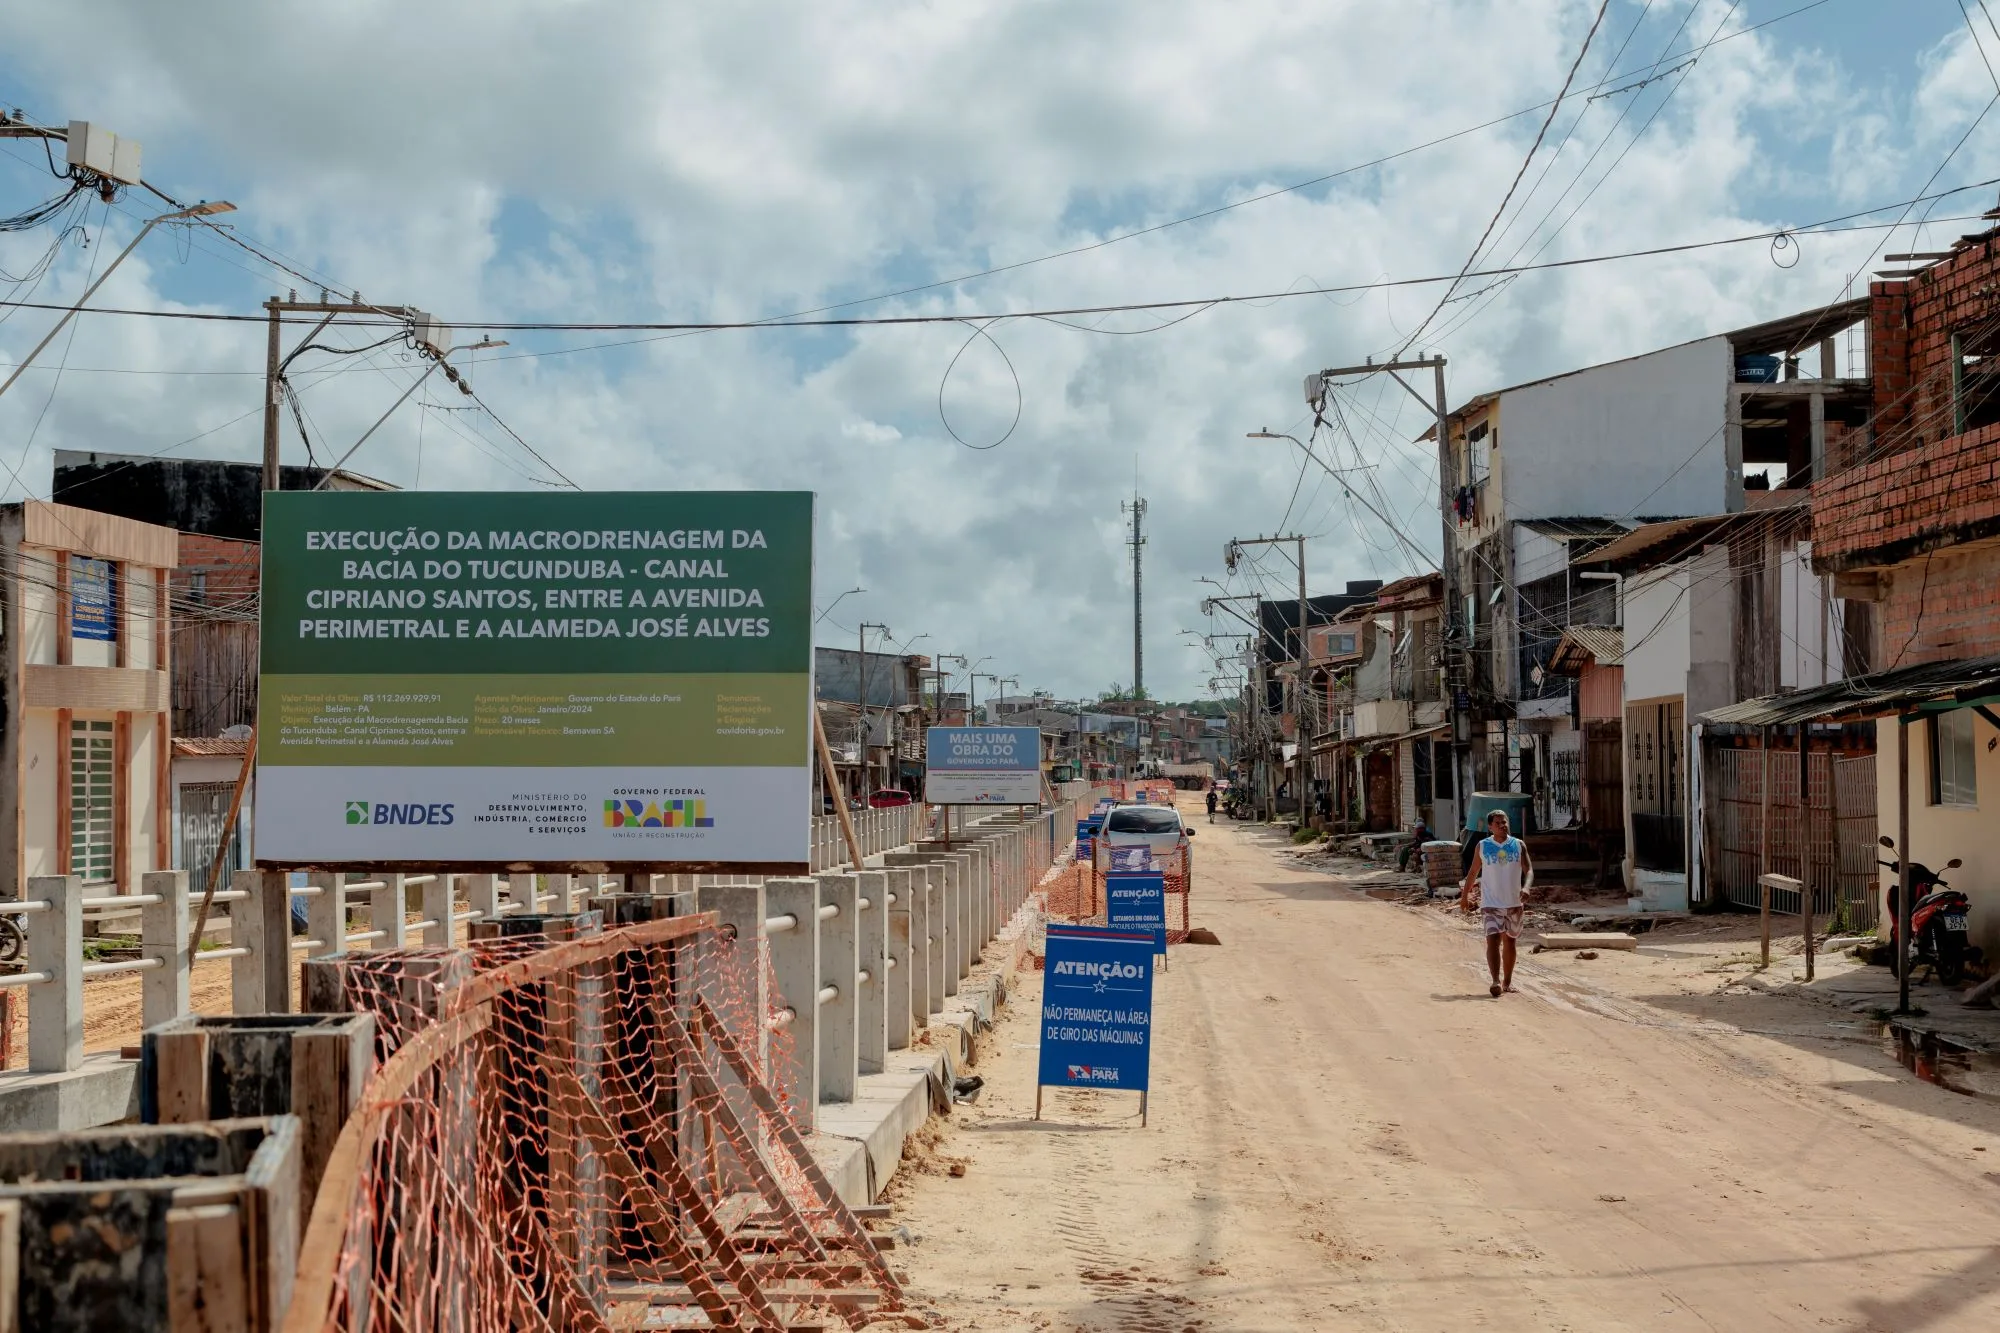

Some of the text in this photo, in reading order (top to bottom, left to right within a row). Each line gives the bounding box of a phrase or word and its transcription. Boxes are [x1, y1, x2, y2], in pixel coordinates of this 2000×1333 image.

[306, 527, 768, 555] EXECUÇÃO DA MACRODRENAGEM DA
[343, 560, 417, 580] BACIA
[424, 560, 462, 580] DO
[468, 560, 624, 579] TUCUNDUBA
[644, 559, 728, 578] CANAL
[306, 588, 764, 612] CIPRIANO SANTOS, ENTRE A AVENIDA
[300, 614, 770, 638] PERIMETRAL E A ALAMEDA JOSÉ ALVES
[281, 694, 302, 702] Valor
[364, 694, 374, 702] R$
[376, 694, 441, 703] 112.269.929,91
[568, 694, 604, 702] Governo
[606, 694, 617, 702] do
[620, 694, 647, 702] Estado
[650, 694, 661, 702] do
[663, 694, 681, 702] Pará
[326, 705, 351, 713] Belém
[537, 705, 592, 713] Janeiro/2024
[313, 716, 352, 725] Execução
[354, 716, 365, 724] da
[446, 716, 468, 724] Bacia
[502, 716, 512, 724] 20
[370, 727, 405, 736] Cipriano
[406, 727, 436, 735] Santos,
[603, 727, 615, 735] SA
[717, 726, 784, 736] ouvidoria.gov.br
[280, 737, 313, 745] Avenida
[315, 737, 356, 745] Perimetral
[372, 737, 408, 745] Alameda
[411, 737, 429, 745] José
[432, 737, 454, 745] Alves
[950, 734, 1017, 744] MAIS UMA
[952, 745, 1013, 756] OBRA DO
[374, 804, 454, 825] BNDES
[474, 814, 587, 823] INDÚSTRIA, COMÉRCIO
[604, 800, 714, 827] BRASIL
[538, 826, 586, 834] SERVIÇOS
[646, 832, 705, 840] RECONSTRUÇÃO
[1112, 888, 1159, 899] ATENÇÃO!
[1054, 960, 1144, 980] ATENÇÃO!
[1044, 1004, 1149, 1026] NÃO PERMANEÇA NA ÁREA
[1048, 1027, 1144, 1045] DE GIRO DAS MÁQUINAS
